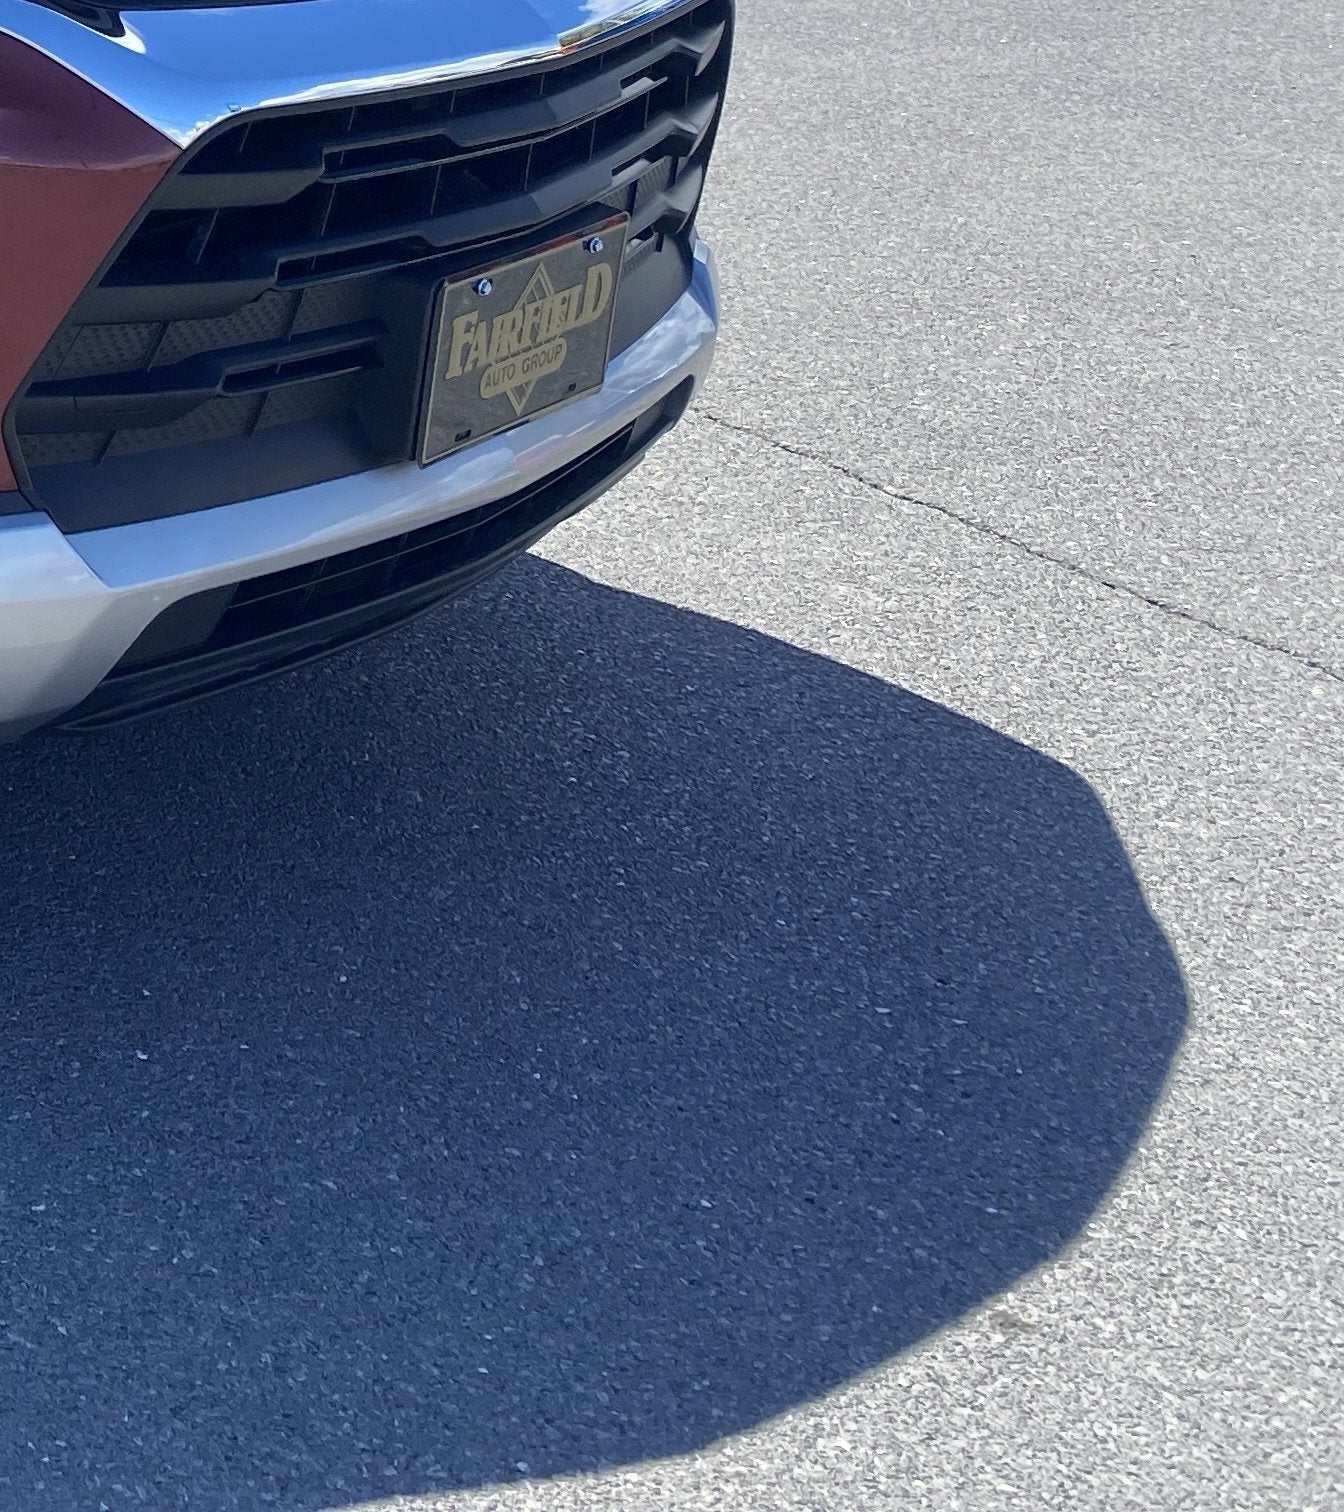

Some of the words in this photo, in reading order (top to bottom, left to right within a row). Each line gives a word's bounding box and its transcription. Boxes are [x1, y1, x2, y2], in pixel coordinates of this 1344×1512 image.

[445, 262, 612, 380] FAIRFIELD
[485, 365, 516, 389] AUTO
[522, 344, 563, 374] GROUP
